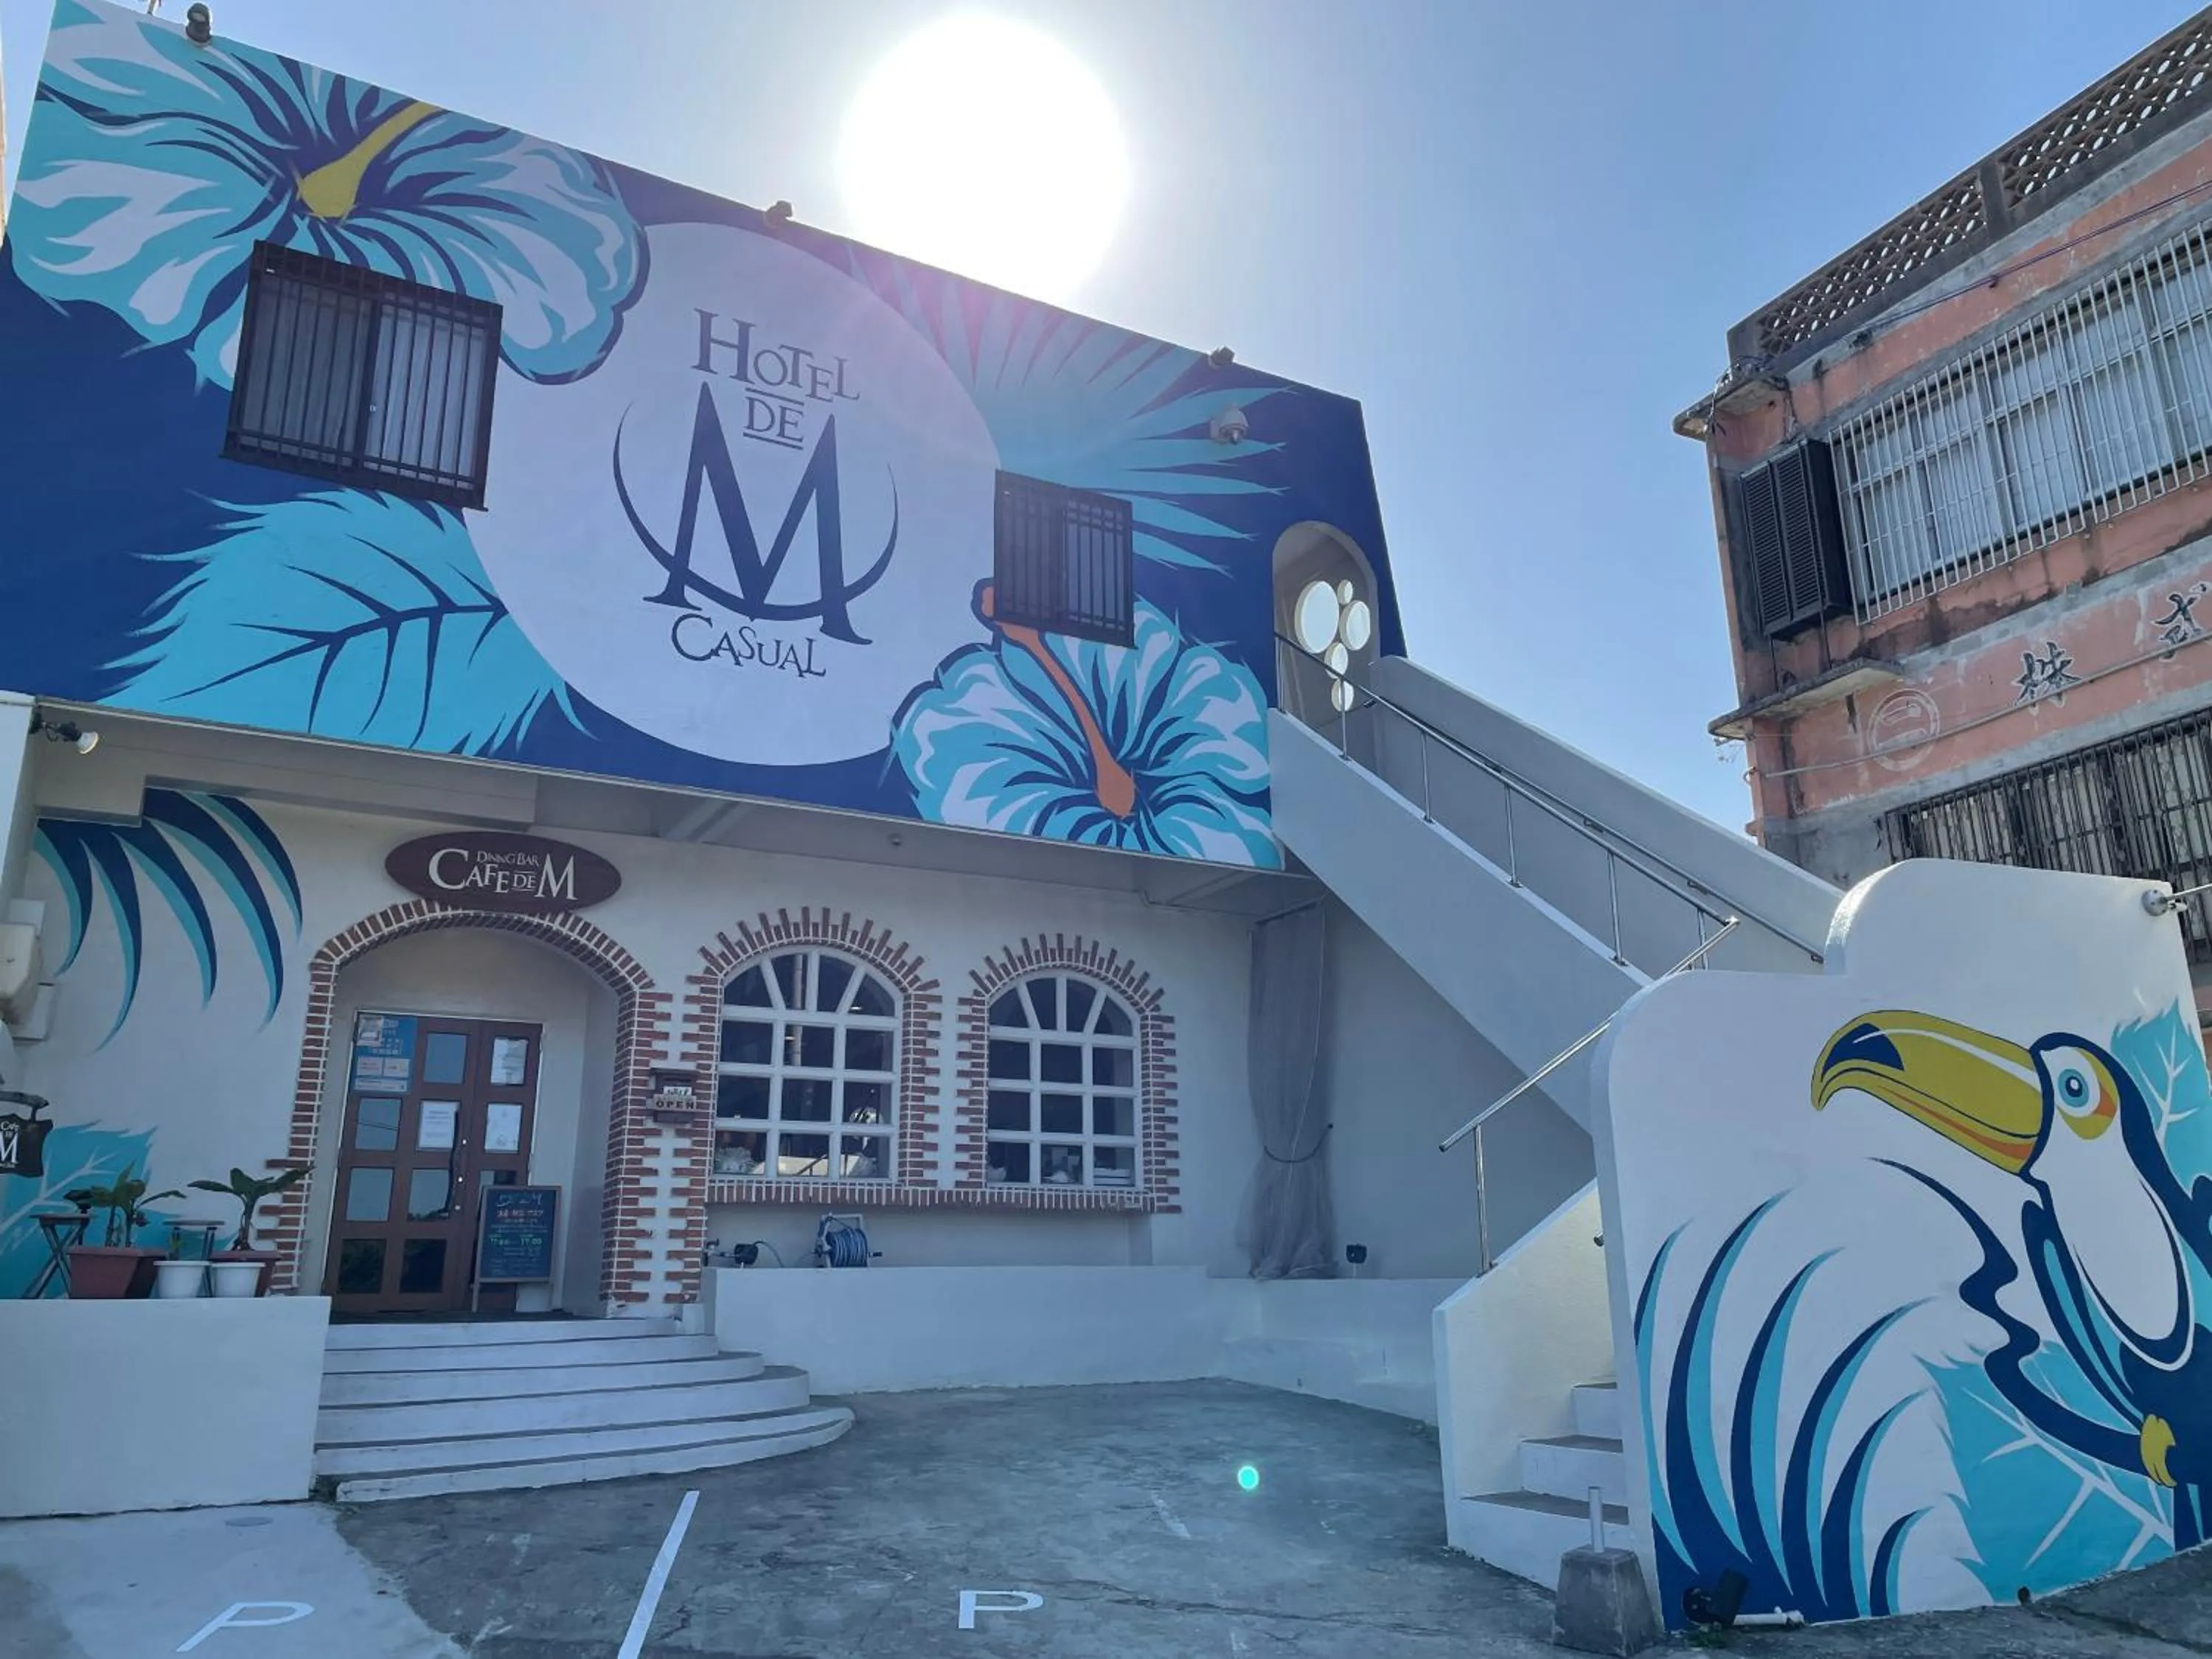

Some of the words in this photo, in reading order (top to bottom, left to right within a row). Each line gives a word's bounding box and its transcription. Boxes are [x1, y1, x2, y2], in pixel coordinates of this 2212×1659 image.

[691, 307, 860, 402] HOTEL
[745, 397, 804, 443] DE
[643, 381, 873, 645] M
[672, 613, 827, 678] CASUAL
[428, 848, 509, 893] CAFE
[513, 873, 537, 889] DE
[534, 852, 579, 900] M
[517, 852, 540, 867] BAR
[655, 1100, 694, 1110] OPEN
[175, 1601, 316, 1652] P
[958, 1590, 1044, 1629] P
